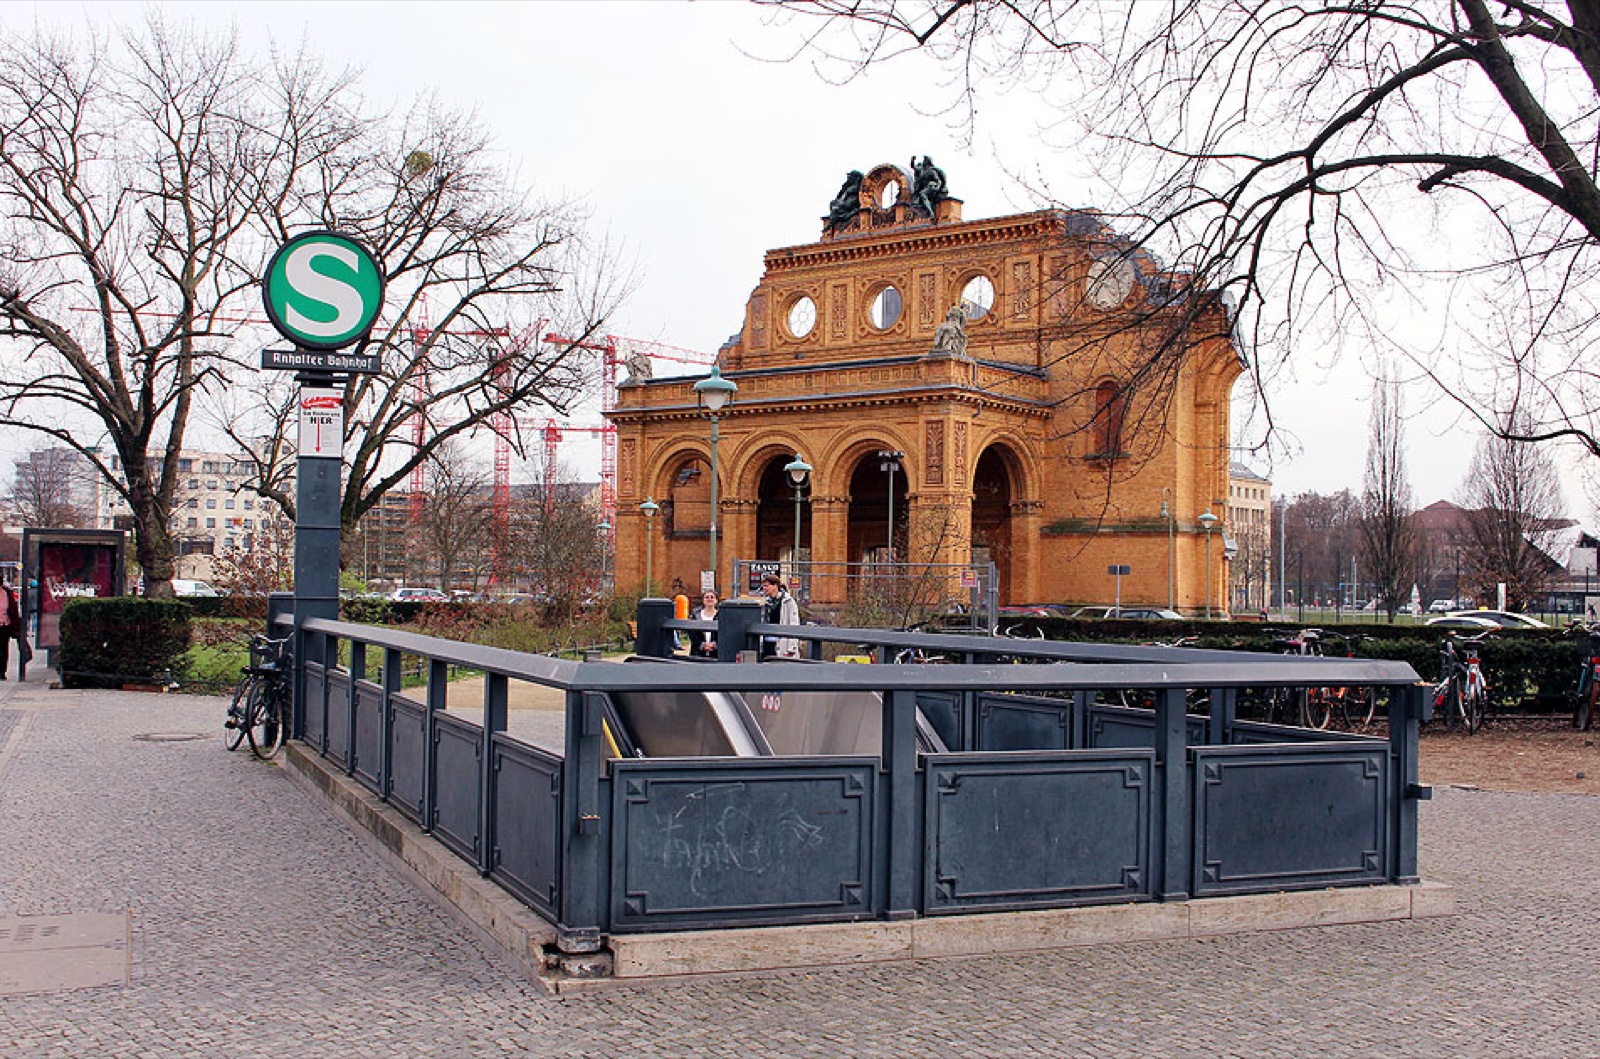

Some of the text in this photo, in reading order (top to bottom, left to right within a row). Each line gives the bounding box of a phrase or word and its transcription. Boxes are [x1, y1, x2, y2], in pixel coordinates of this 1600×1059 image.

[286, 242, 363, 337] S
[273, 353, 372, 369] Anhalter Bahnhof
